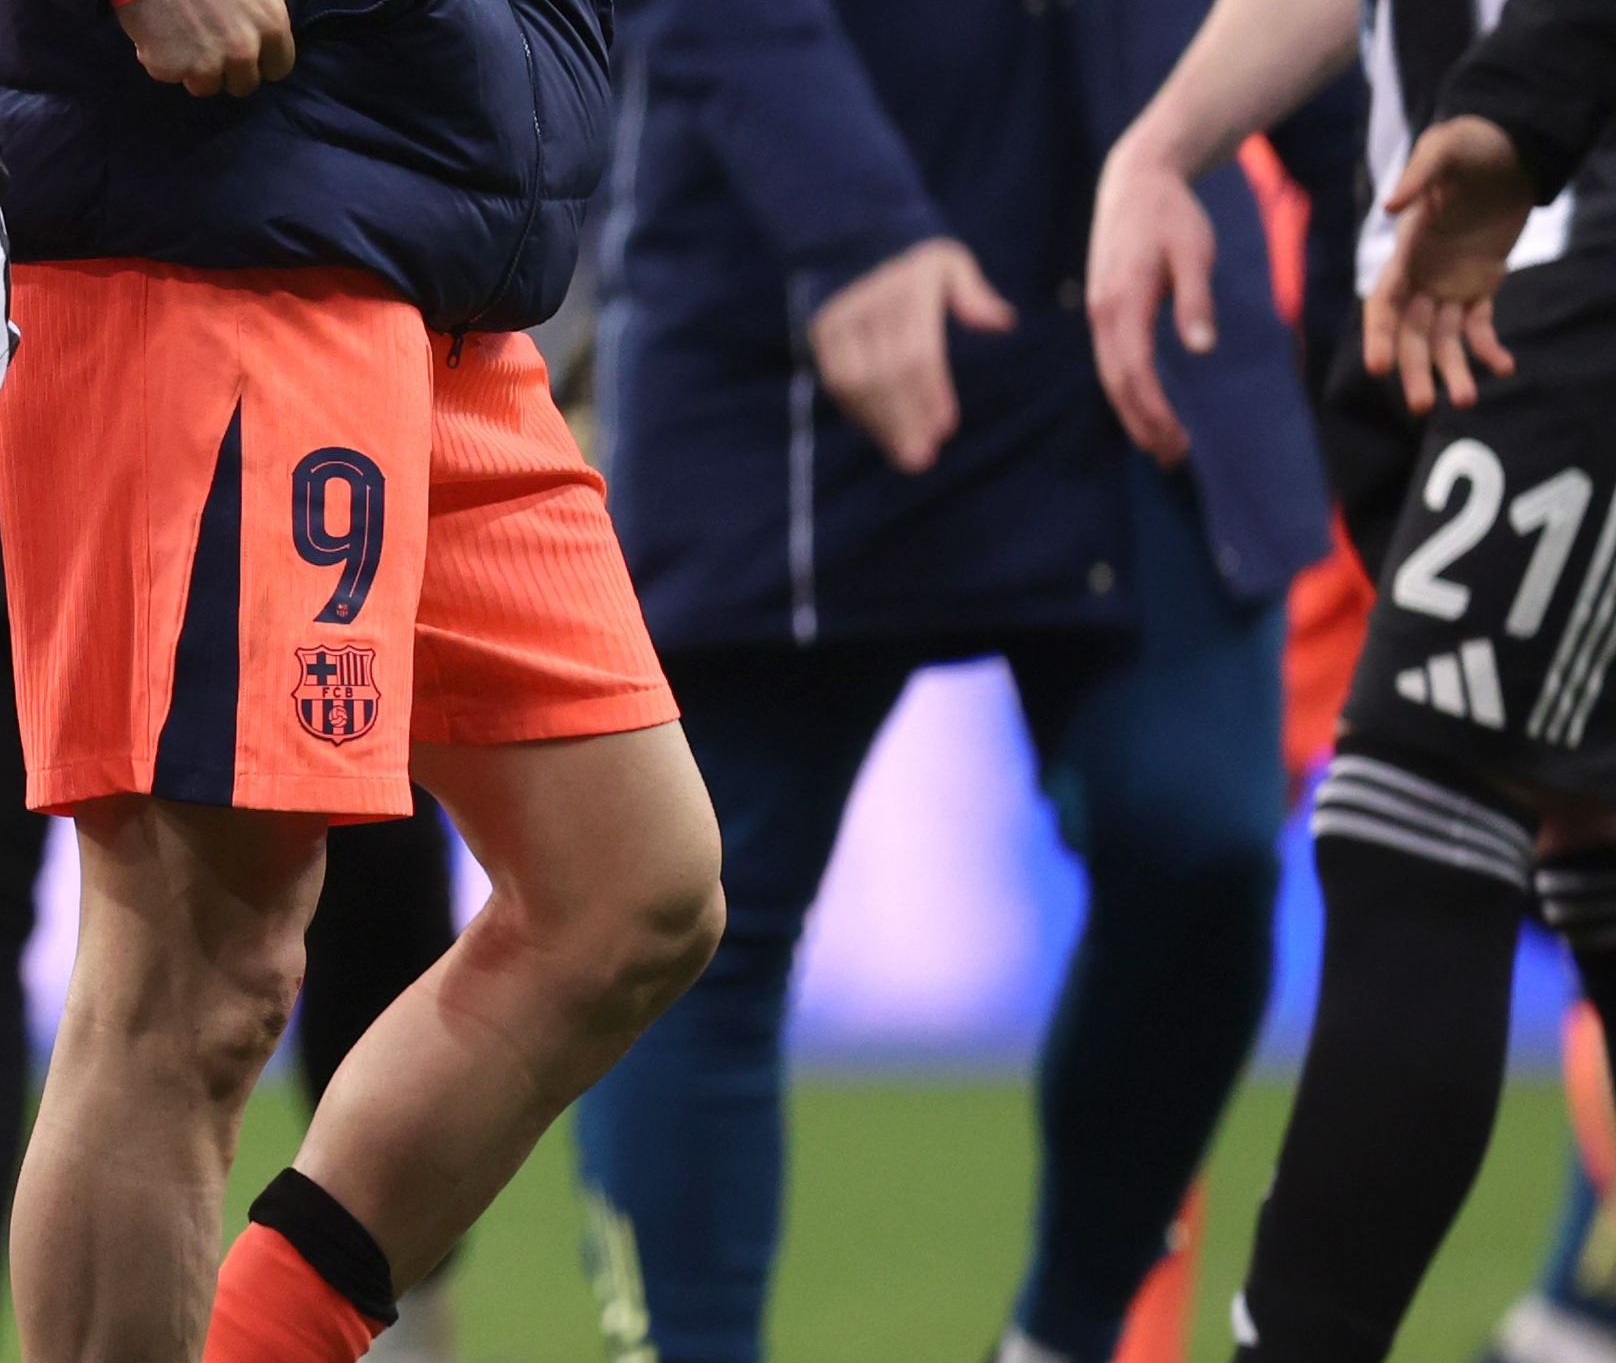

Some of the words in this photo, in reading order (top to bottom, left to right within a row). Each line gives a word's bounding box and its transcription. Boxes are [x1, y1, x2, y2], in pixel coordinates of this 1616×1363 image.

[291, 446, 386, 625] 9
[1393, 437, 1593, 640] 21
[321, 685, 354, 699] FCB
